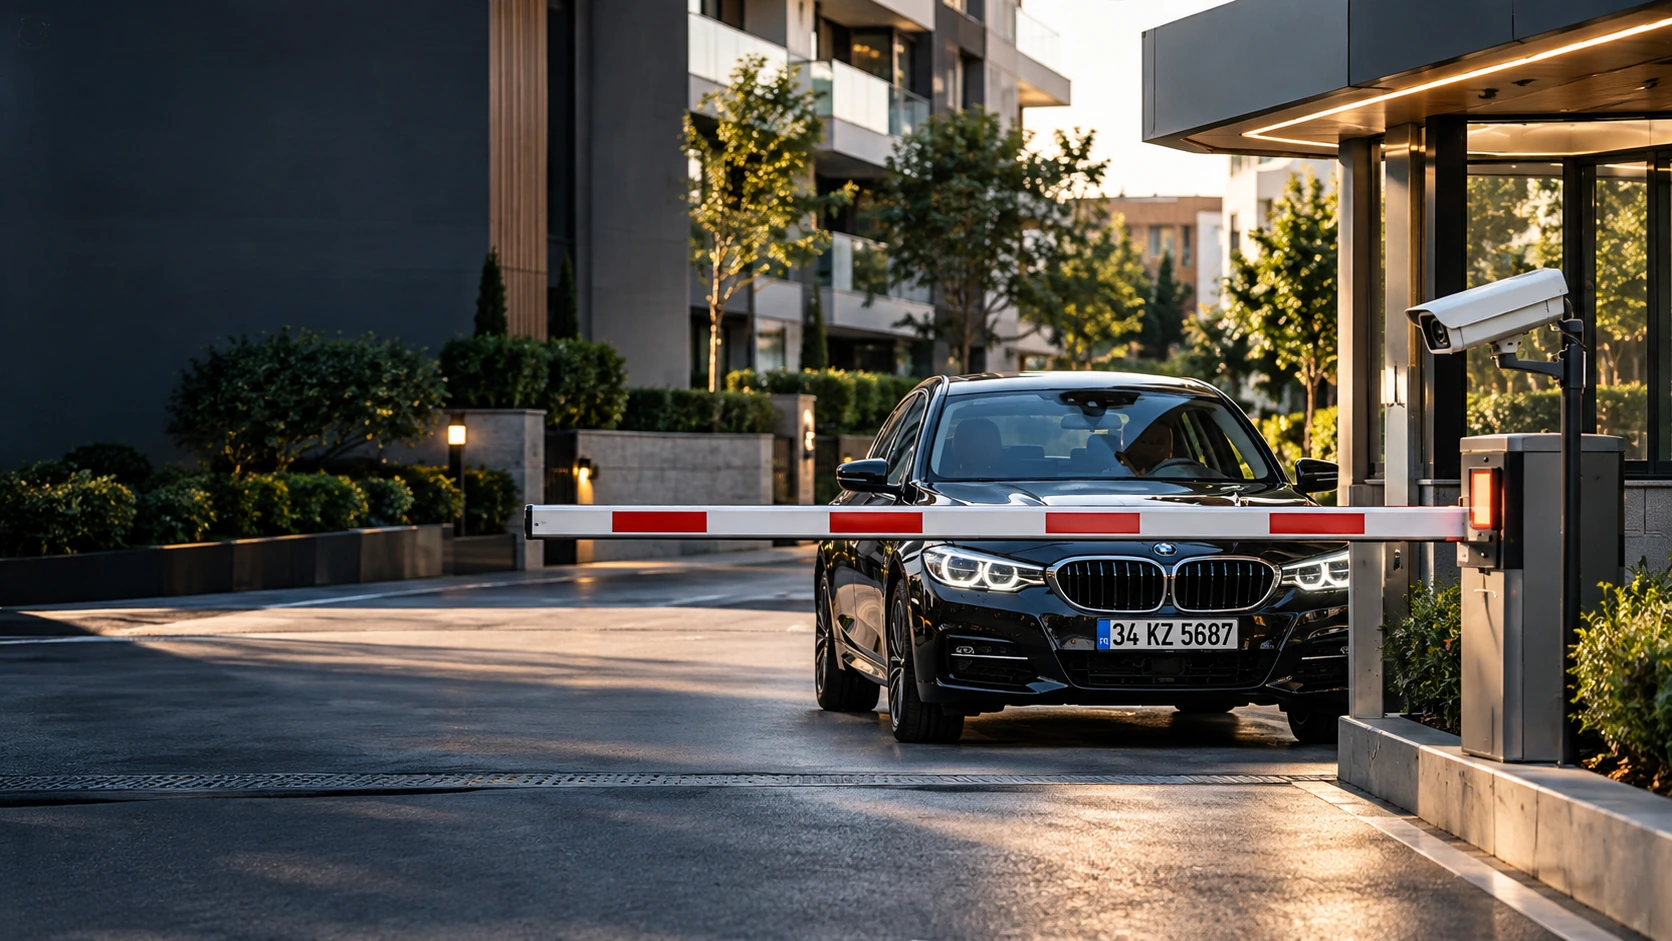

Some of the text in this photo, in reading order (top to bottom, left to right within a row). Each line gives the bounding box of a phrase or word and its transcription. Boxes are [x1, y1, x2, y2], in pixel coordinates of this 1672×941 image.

[1112, 622, 1234, 646] 34 KZ 5687
